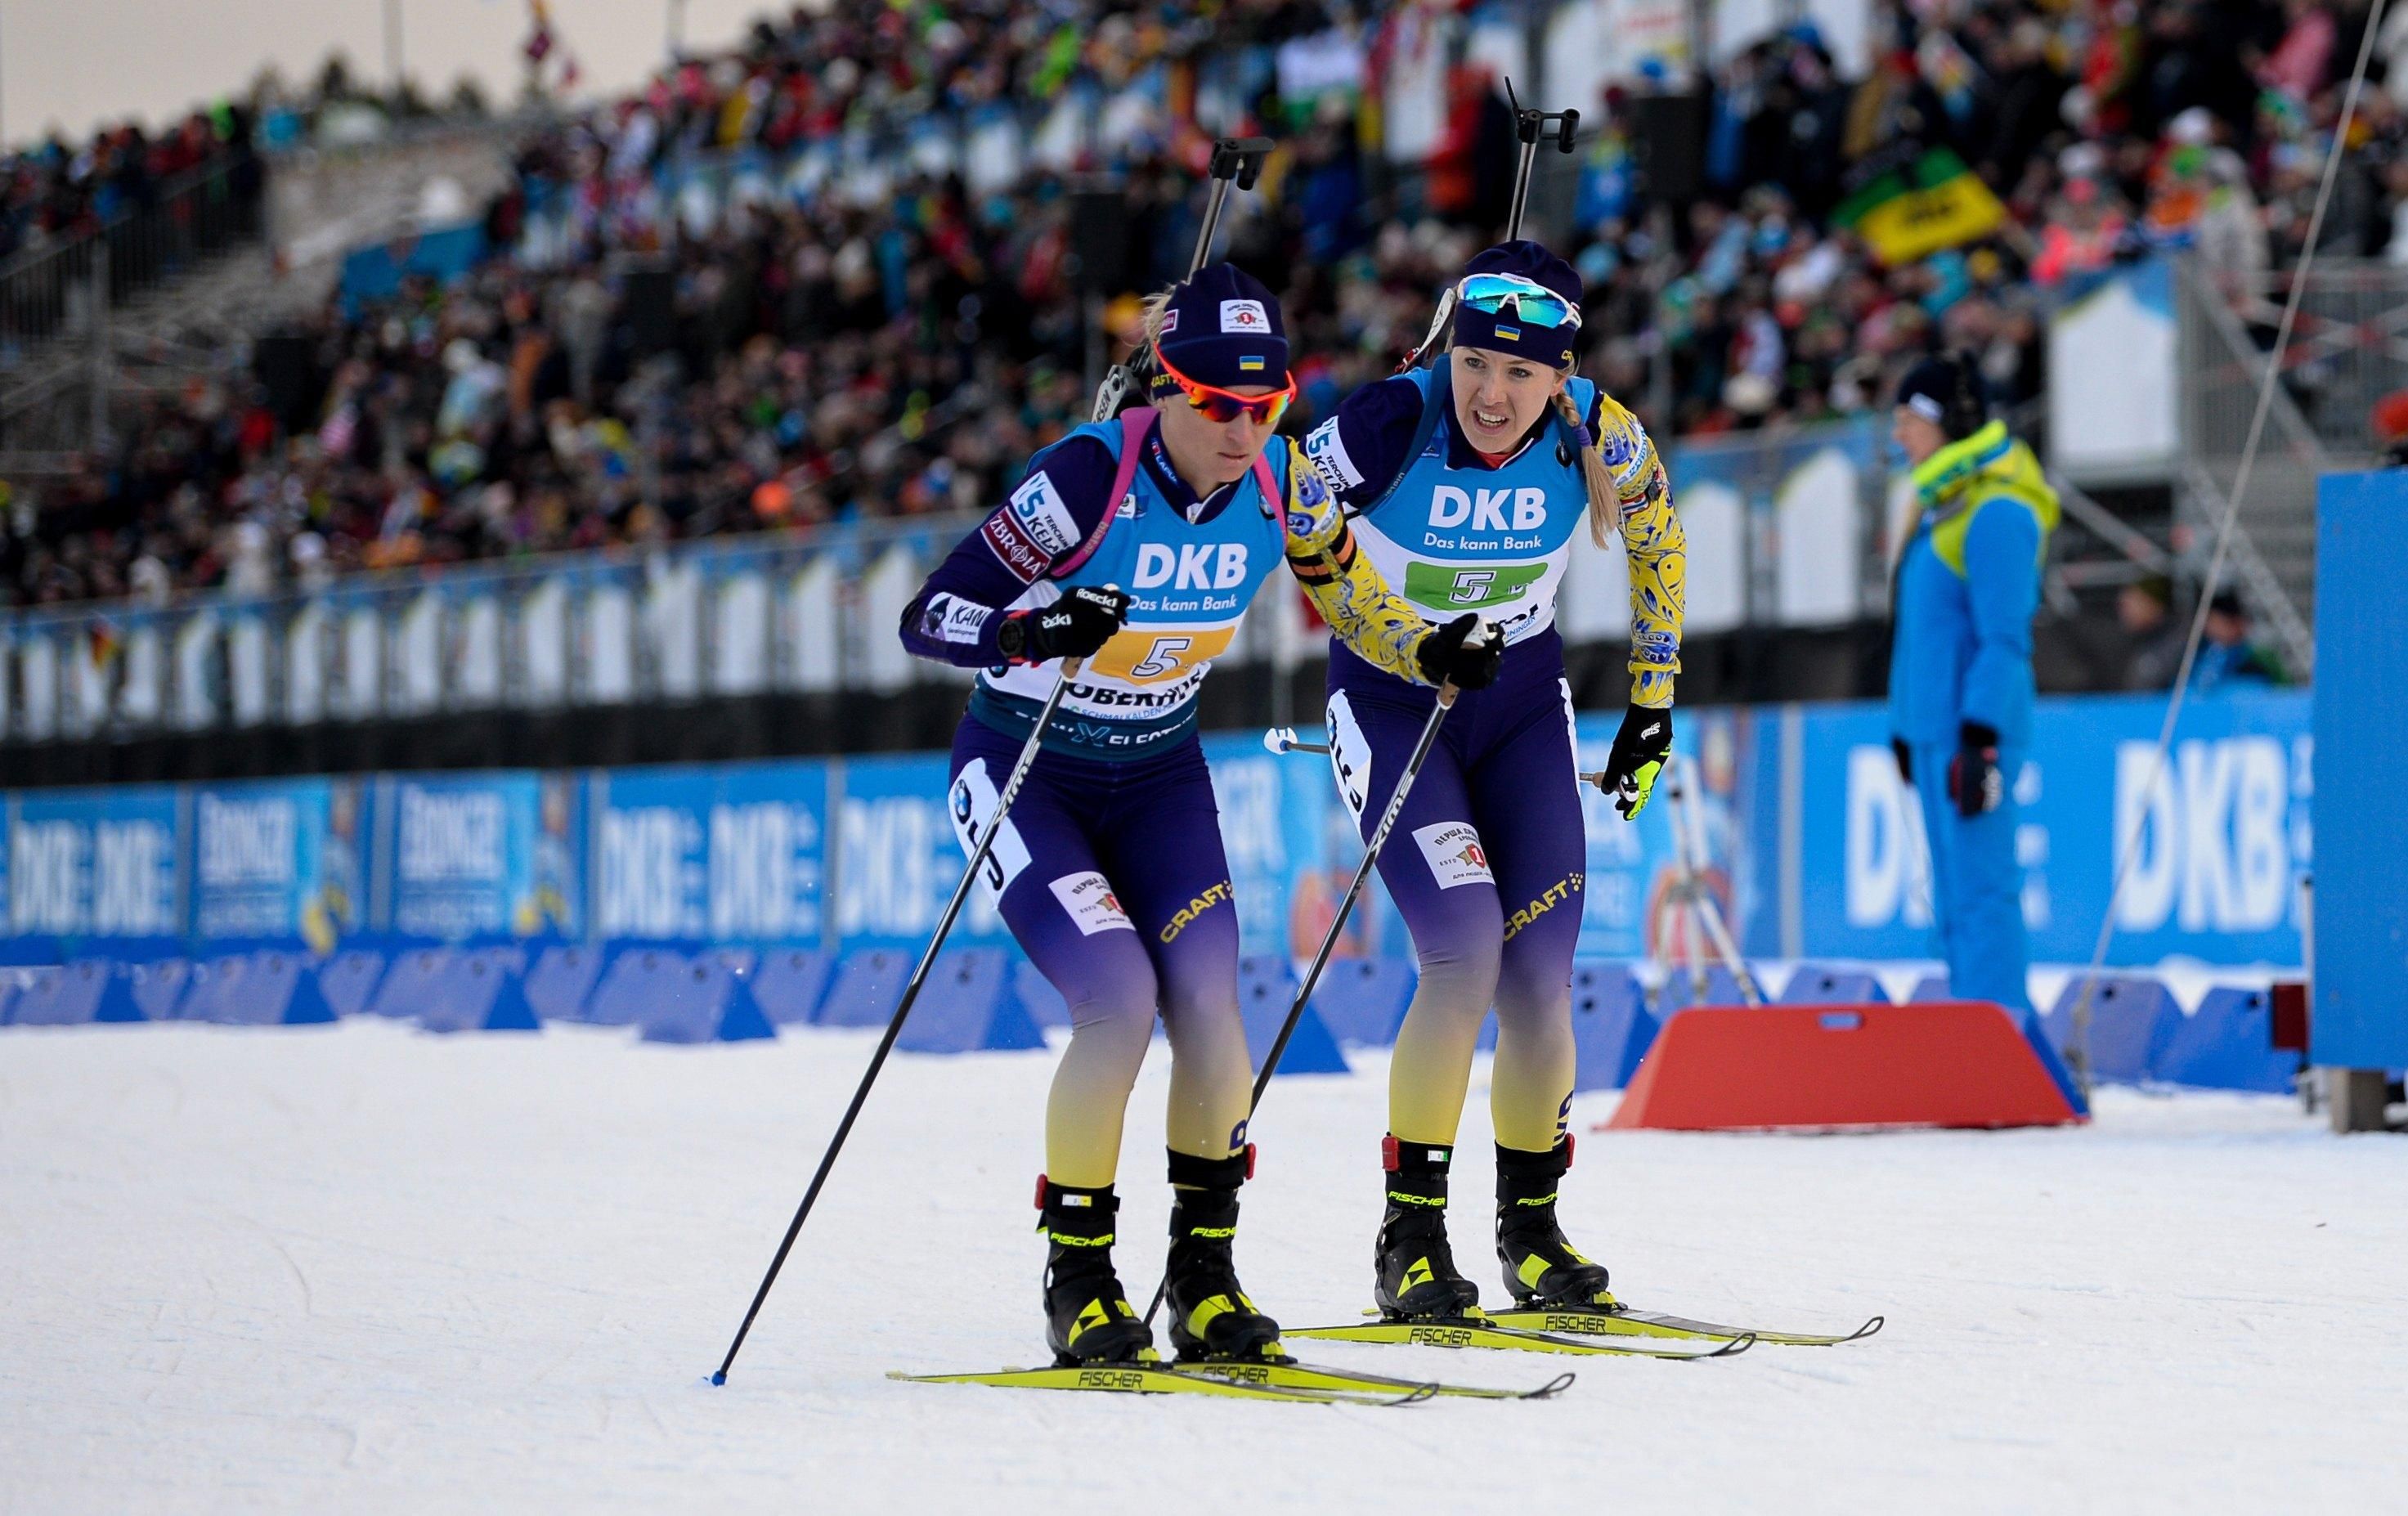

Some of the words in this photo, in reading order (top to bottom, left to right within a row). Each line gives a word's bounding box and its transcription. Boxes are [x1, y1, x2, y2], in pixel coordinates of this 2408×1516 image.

[1428, 485, 1547, 531] DKB
[1424, 531, 1455, 549] Das
[1460, 536, 1499, 550] kann
[1503, 535, 1542, 549] Bank
[1132, 543, 1248, 590] DKB
[1448, 571, 1497, 603] 5
[1126, 595, 1158, 611] Das
[1161, 596, 1198, 612] kann
[1202, 594, 1237, 611] Bank
[1131, 637, 1194, 678] 5
[2114, 738, 2287, 931] DKB
[1159, 883, 1226, 944] CRAFT
[1503, 879, 1568, 941] CRAFT
[1516, 1192, 1558, 1206] FISCH
[1050, 1232, 1114, 1247] FISCHER
[1191, 1227, 1237, 1239] FISCH
[1545, 1315, 1606, 1333] FISCHER
[1408, 1327, 1473, 1345] FISCHER
[1078, 1371, 1143, 1388] FISCHER
